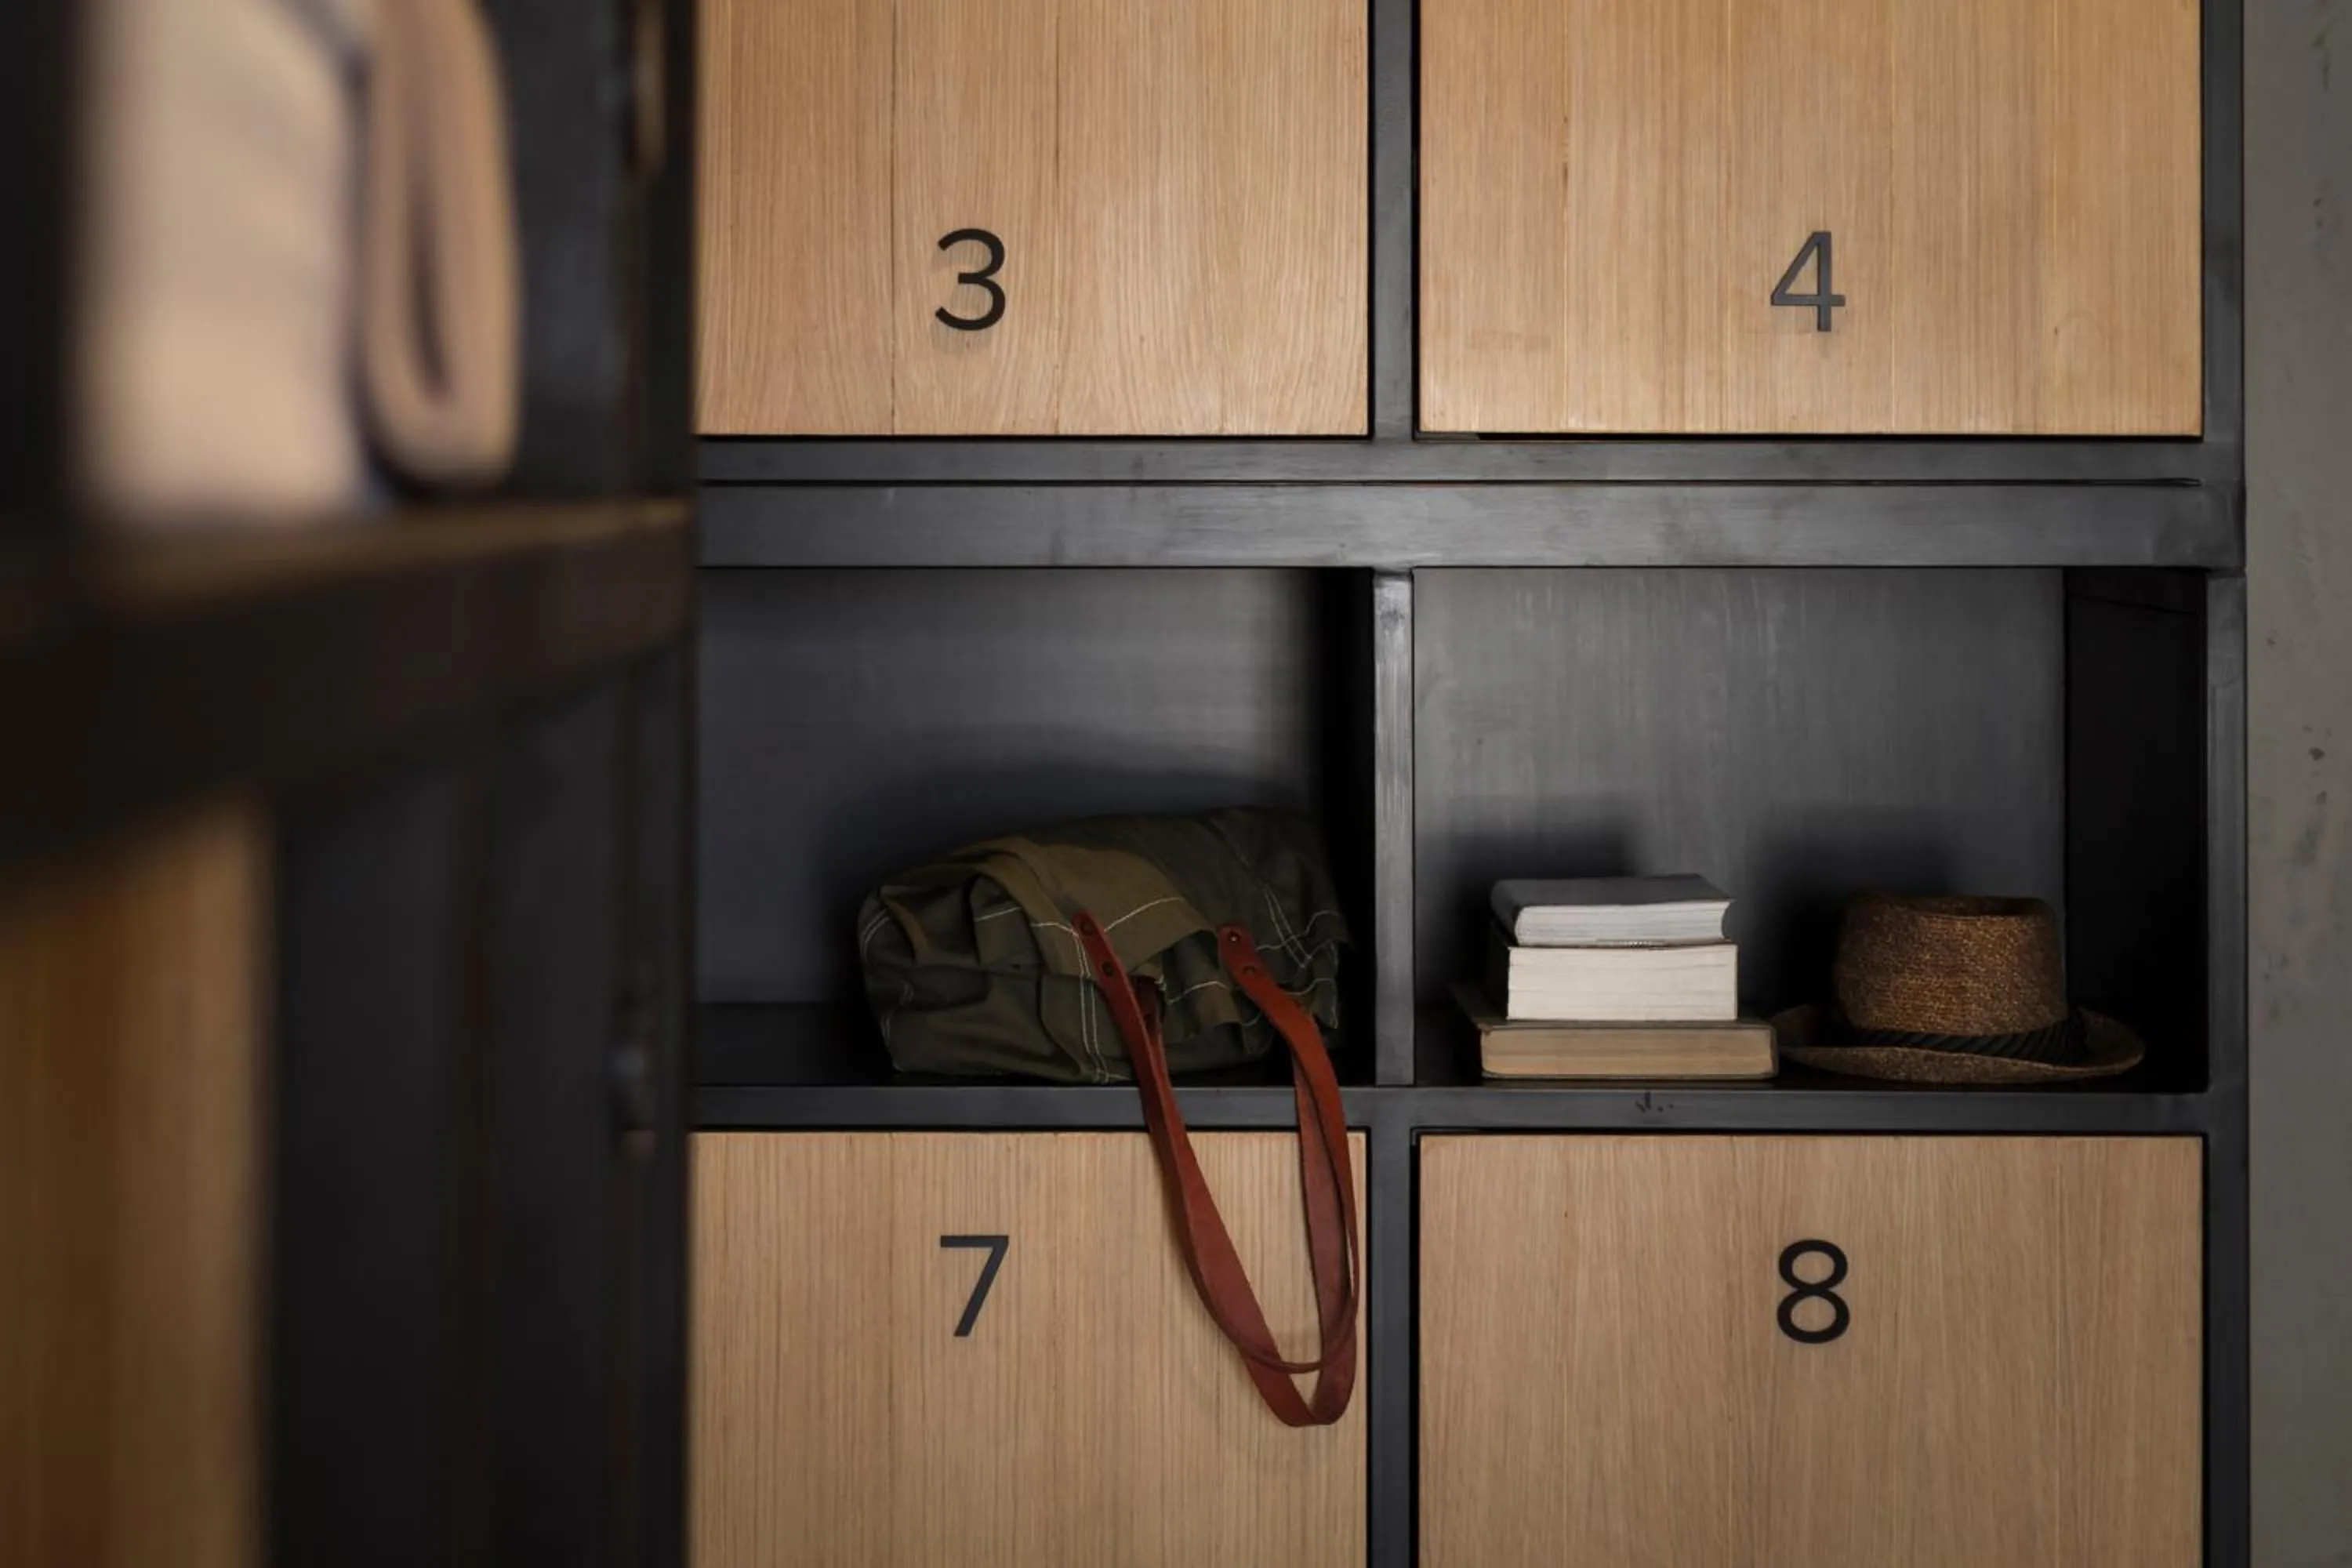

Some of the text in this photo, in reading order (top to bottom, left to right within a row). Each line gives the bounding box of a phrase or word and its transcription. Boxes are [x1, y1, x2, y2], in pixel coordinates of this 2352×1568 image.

[935, 227, 1006, 332] 3
[1769, 230, 1846, 333] 4
[939, 1234, 1010, 1338] 7
[1776, 1239, 1850, 1345] 8
